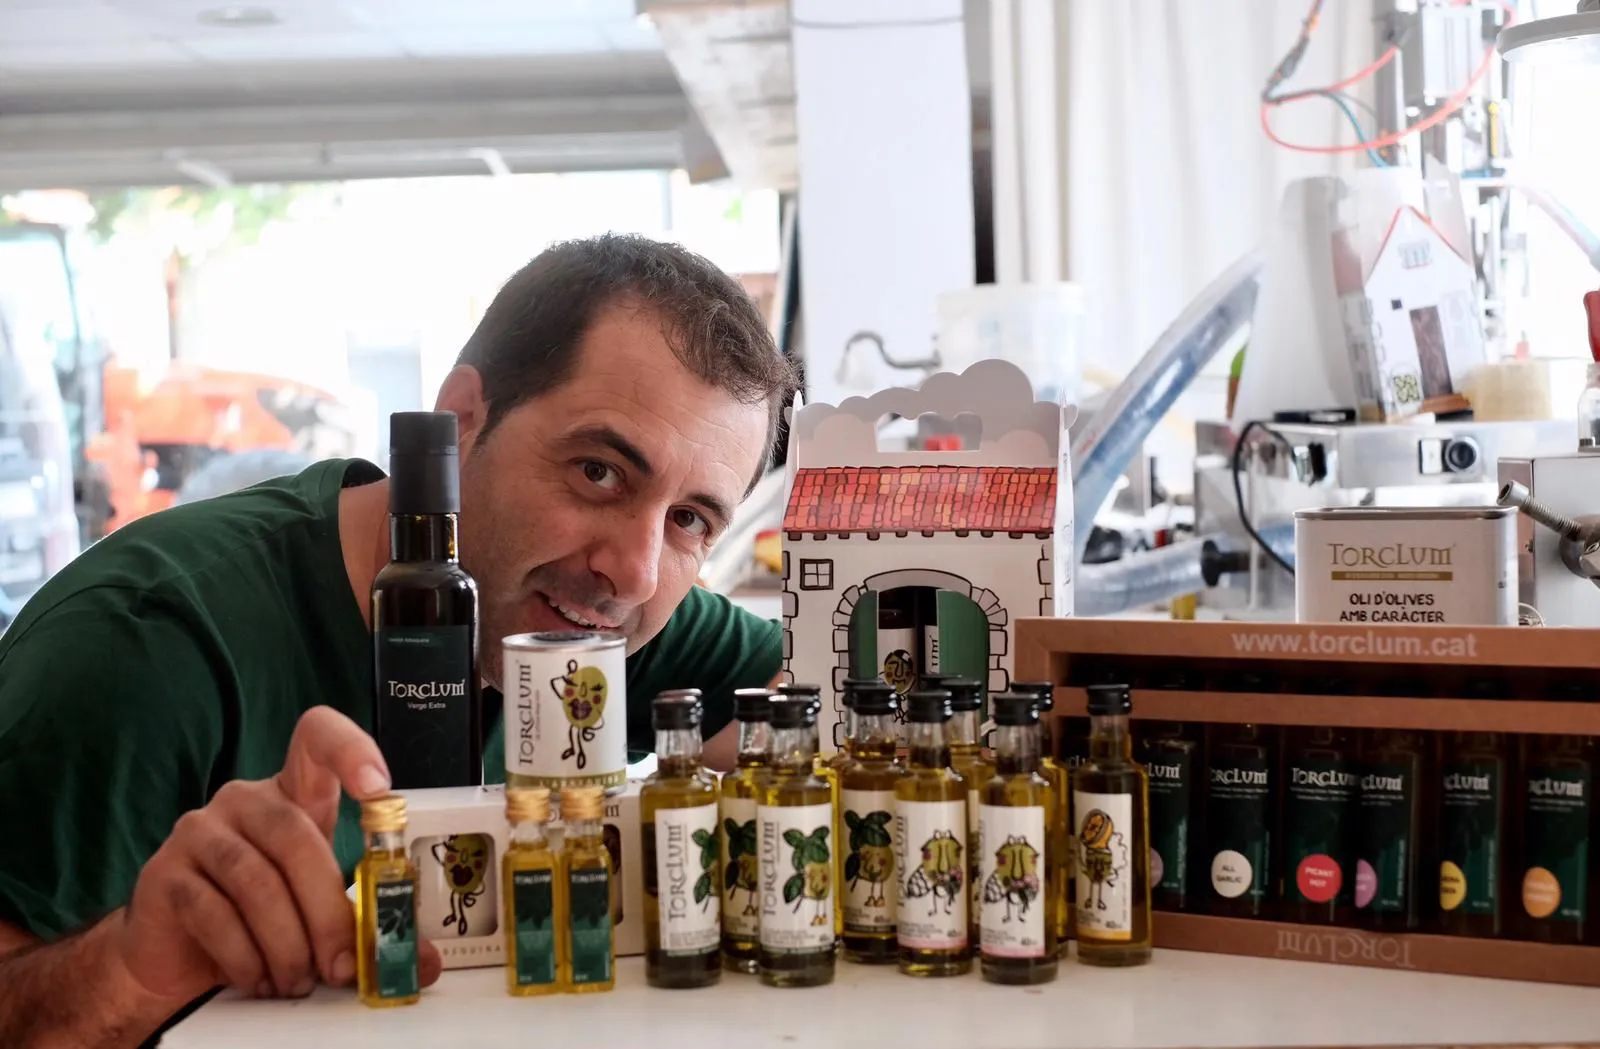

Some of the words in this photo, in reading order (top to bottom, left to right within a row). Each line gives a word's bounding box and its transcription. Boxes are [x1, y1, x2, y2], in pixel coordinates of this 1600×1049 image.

[1327, 542, 1456, 569] TORCLUM
[1349, 593, 1371, 605] OLI
[1374, 591, 1435, 605] D'OLIVES
[1339, 610, 1368, 622] AMB
[1371, 606, 1445, 622] CARÀCTER
[1232, 629, 1478, 658] www.torclum.cat
[387, 679, 466, 699] TORCLUM
[407, 701, 427, 711] Verge
[428, 701, 447, 710] Extra
[517, 663, 535, 767] TORCLUM
[665, 822, 687, 922] TORCLUM
[762, 820, 778, 917] TORCLUM
[1222, 864, 1236, 872] ALL
[1309, 879, 1328, 888] HOT
[1276, 929, 1416, 968] TORCLUM
